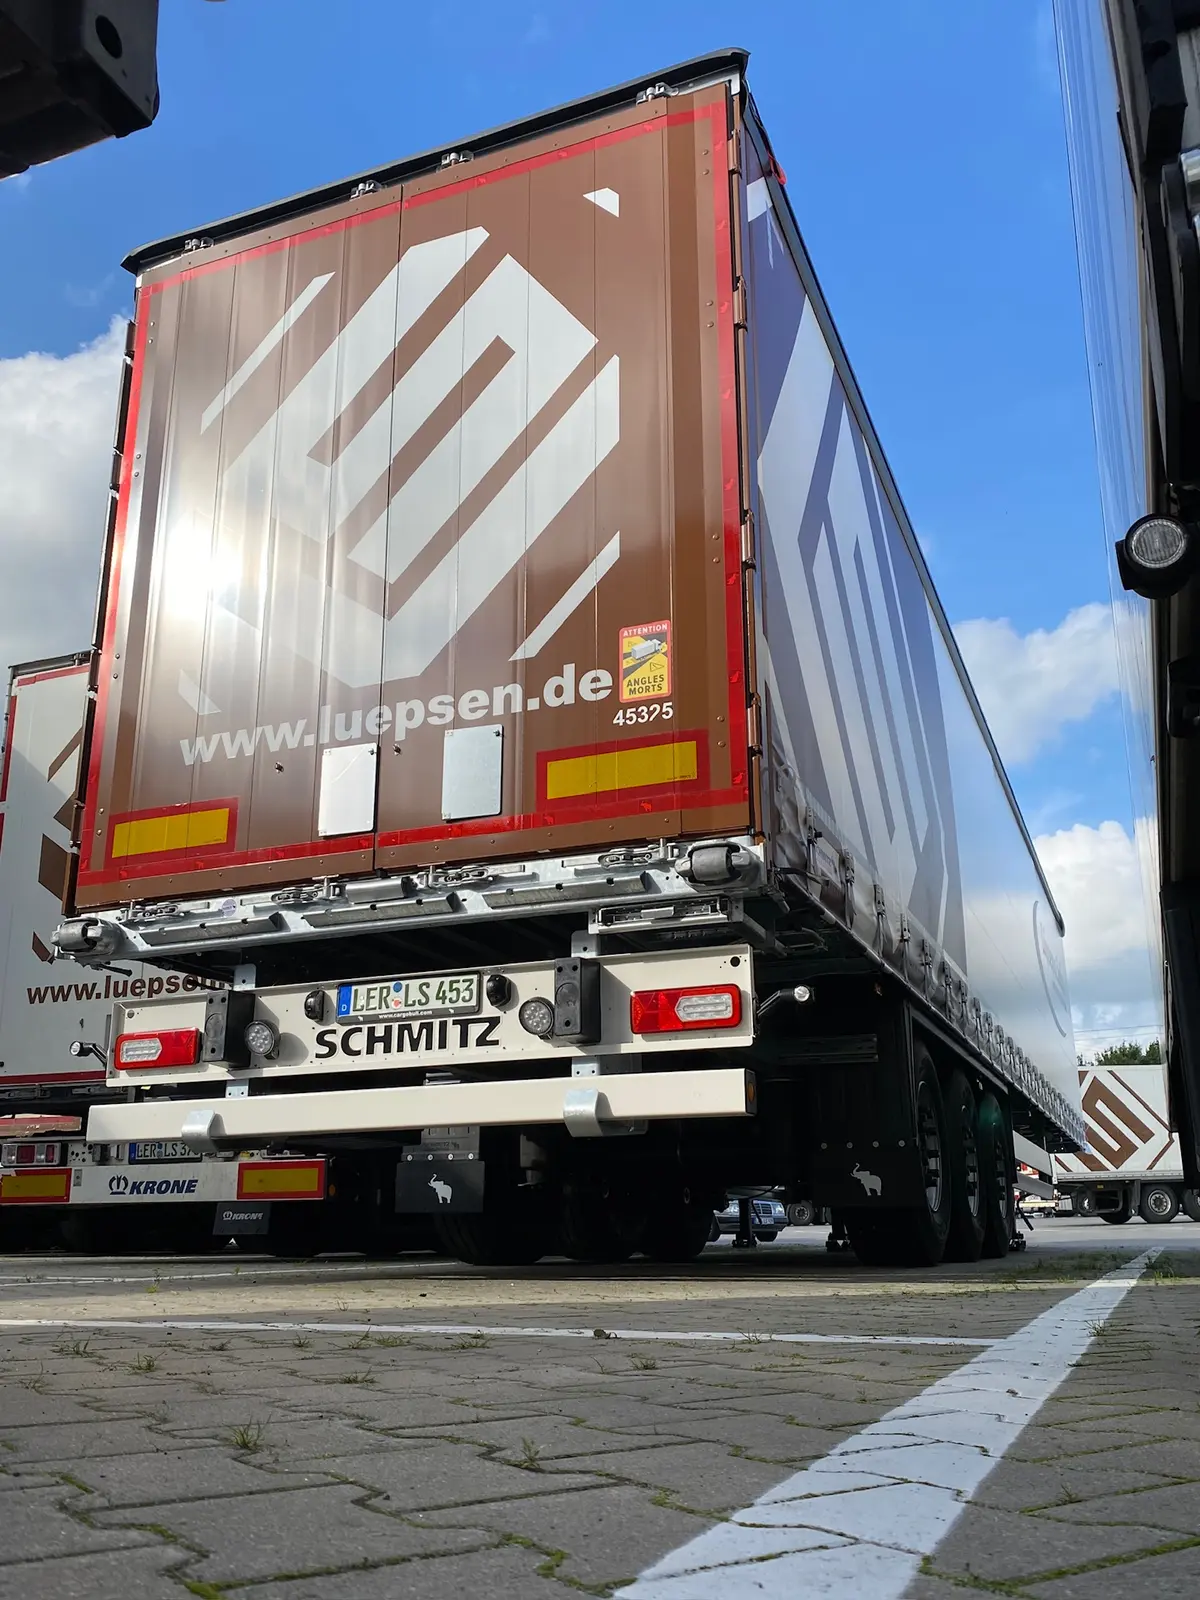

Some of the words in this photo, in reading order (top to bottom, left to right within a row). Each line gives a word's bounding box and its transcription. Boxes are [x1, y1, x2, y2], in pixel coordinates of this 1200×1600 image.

[623, 622, 668, 637] ATTENTION
[627, 674, 664, 688] ANGLES
[629, 683, 663, 696] MORTS
[180, 663, 613, 765] www.luepsen.de
[352, 986, 391, 1012] LER
[404, 982, 431, 1007] LS
[436, 978, 475, 1005] 453
[378, 1010, 433, 1020] www.cargobull.com
[315, 1016, 501, 1059] SCHMITZ
[137, 1143, 156, 1158] LER
[164, 1142, 178, 1157] LS
[129, 1179, 198, 1195] KRONE
[232, 1212, 264, 1220] KRONE
